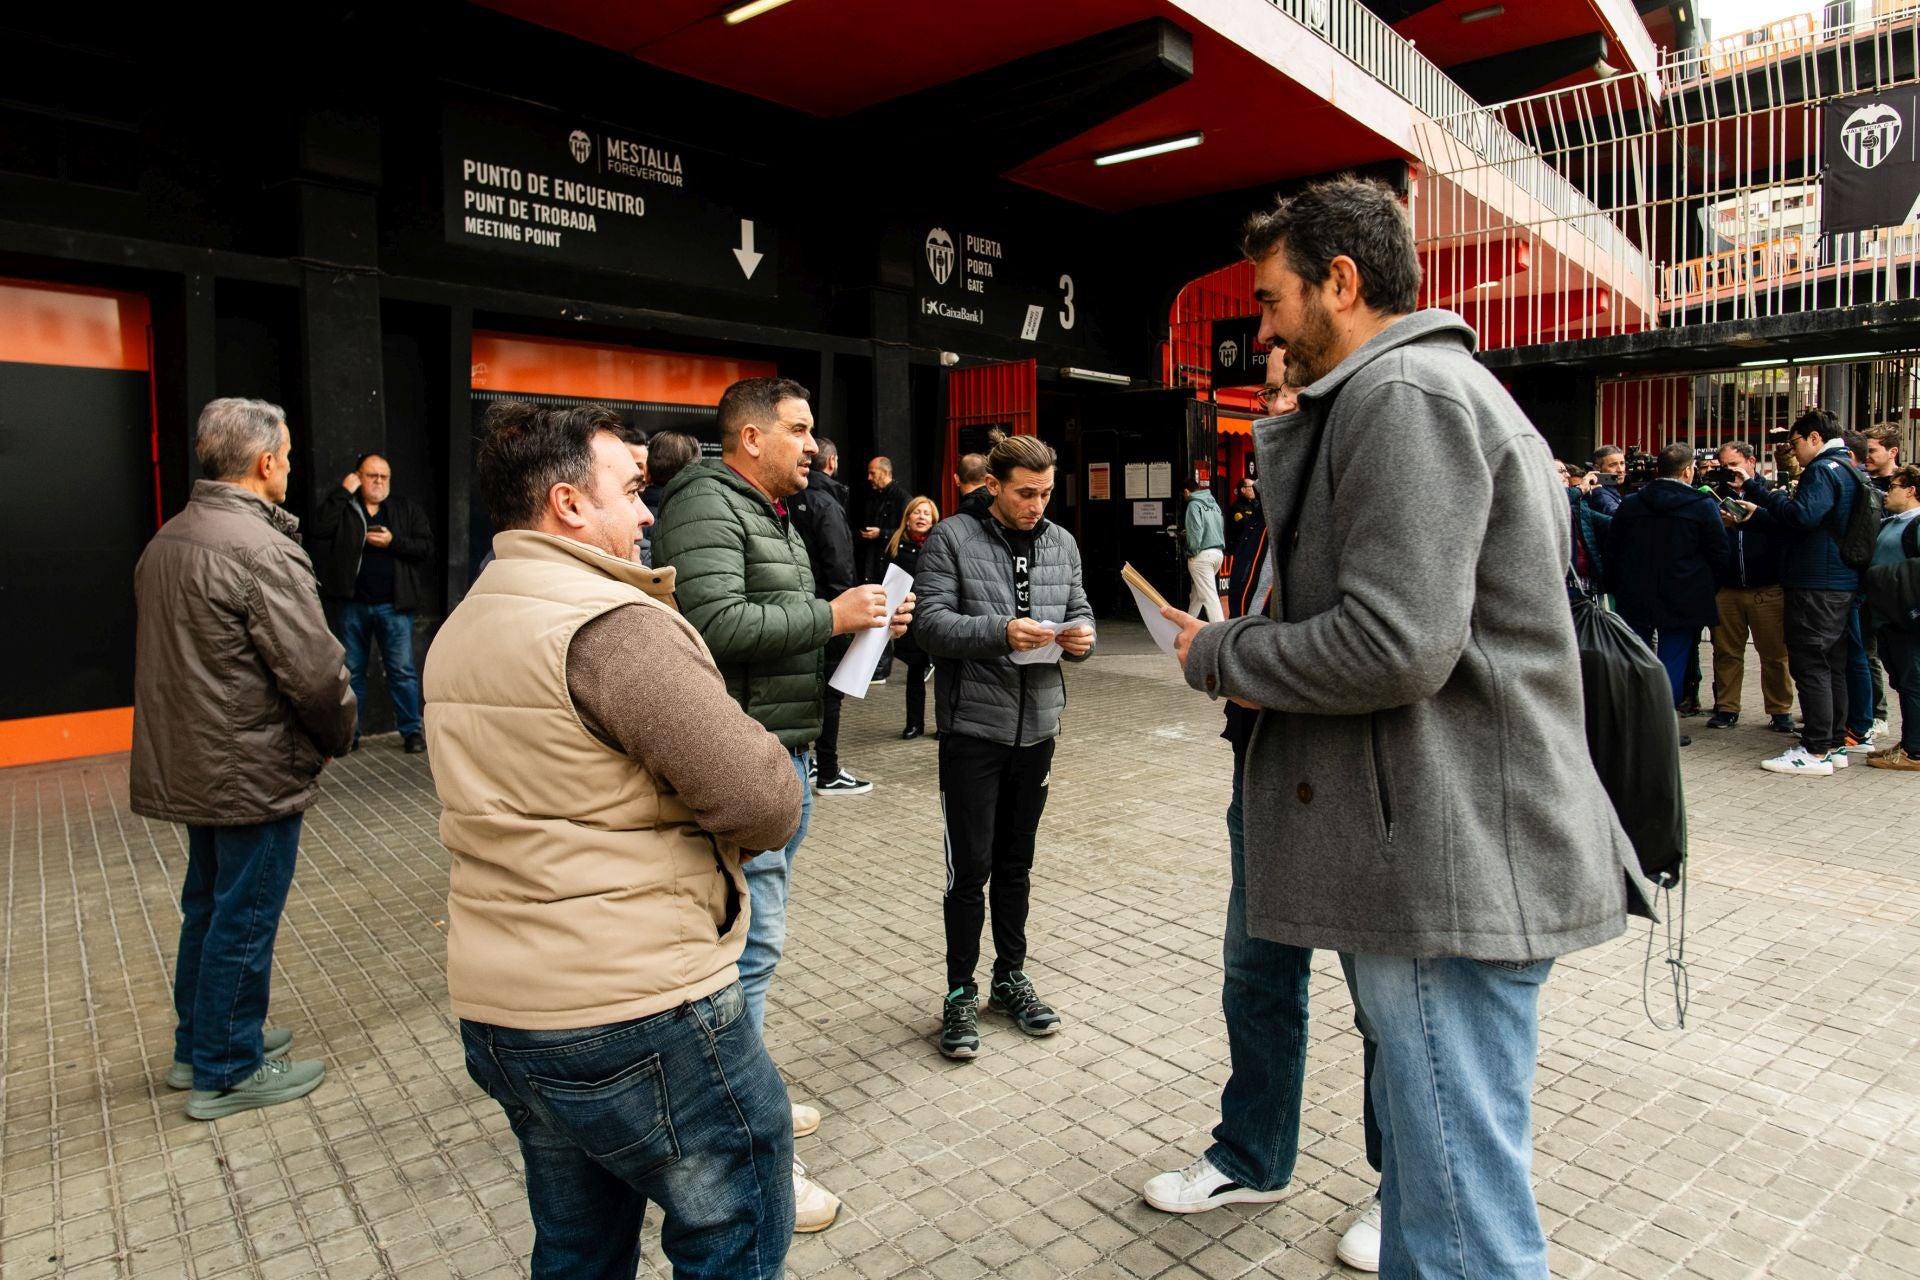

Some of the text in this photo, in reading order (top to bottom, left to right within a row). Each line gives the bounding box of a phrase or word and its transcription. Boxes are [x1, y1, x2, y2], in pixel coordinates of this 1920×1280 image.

[607, 137, 683, 175] MESTALLA
[463, 158, 645, 217] PUNTO DE ENCUENTRO
[607, 159, 683, 187] FOREVERTOUR
[464, 189, 597, 233] PUNT DE TROBADA
[464, 215, 562, 248] MEETING POINT
[966, 234, 1002, 259] PUERTA
[967, 258, 993, 278] PORTA
[967, 278, 984, 294] GATE
[939, 303, 980, 323] CaixaBank
[1059, 274, 1075, 330] 3
